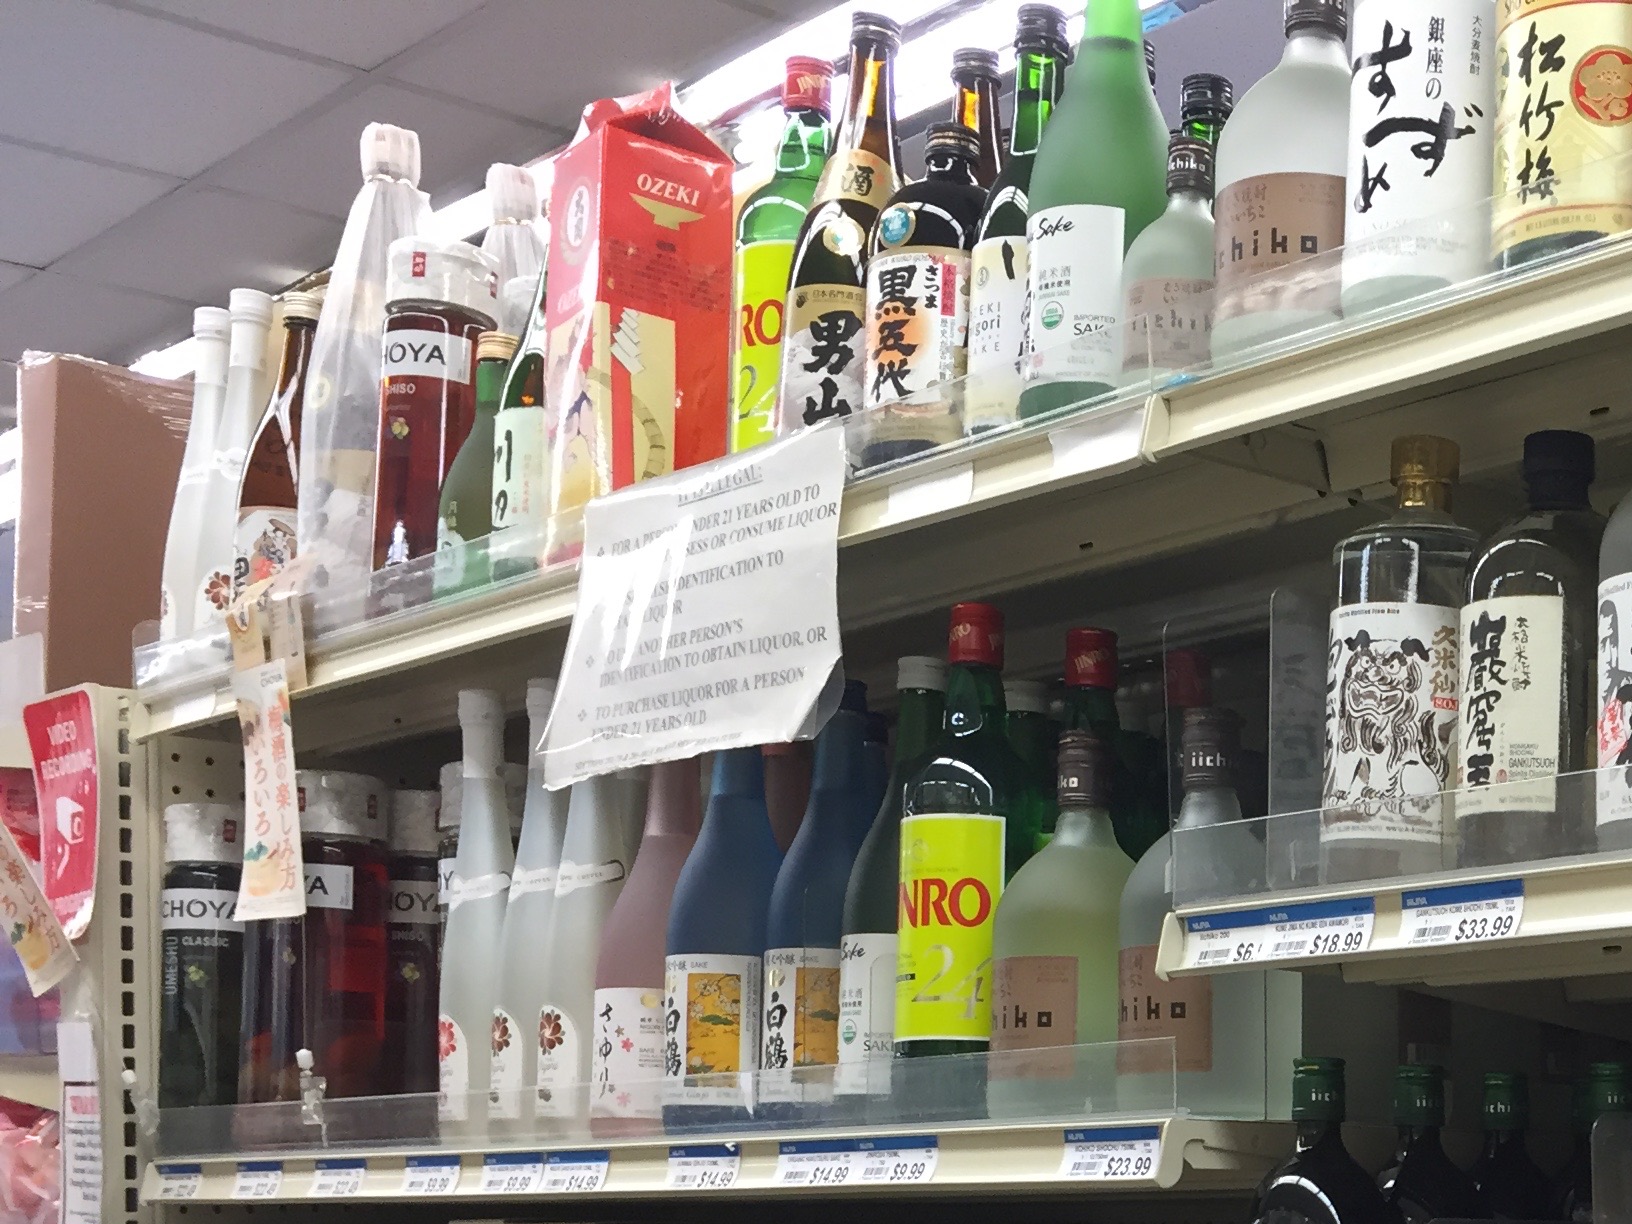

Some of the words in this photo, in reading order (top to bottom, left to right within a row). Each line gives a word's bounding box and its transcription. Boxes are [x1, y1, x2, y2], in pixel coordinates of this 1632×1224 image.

[1425, 16, 1446, 100] 銀座の
[1469, 15, 1483, 76] 大分麦焼酎
[1516, 21, 1567, 206] 松竹梅
[636, 171, 702, 209] OZEKI
[1036, 215, 1075, 240] Sake
[924, 264, 940, 310] さつま
[1073, 314, 1116, 324] IMPORTED
[802, 310, 864, 427] 男山
[735, 497, 774, 521] YEARS
[776, 489, 801, 509] OLD
[805, 482, 820, 500] TO
[729, 517, 785, 542] CONSUME
[787, 502, 837, 528] LIQUOR
[767, 549, 784, 567] TO
[702, 639, 747, 664] OBTAIN
[807, 625, 827, 645] OR
[1429, 625, 1458, 697] 久米仙
[671, 683, 714, 707] LIQUOR
[753, 666, 807, 690] PERSON
[645, 713, 682, 734] YEARS
[684, 709, 706, 726] OLD
[1310, 931, 1363, 955] $18.99
[1455, 914, 1514, 940] $33.99
[164, 936, 178, 996] UMESHU
[181, 946, 230, 968] CLASSIC
[764, 999, 790, 1071] 白鶴
[699, 1169, 734, 1188] $14.99
[809, 1164, 850, 1187] $14.99
[889, 1161, 926, 1182] $9.99
[1103, 1155, 1152, 1177] $23.99
[504, 1173, 532, 1192] $9.99
[565, 1174, 599, 1191] $14.99
